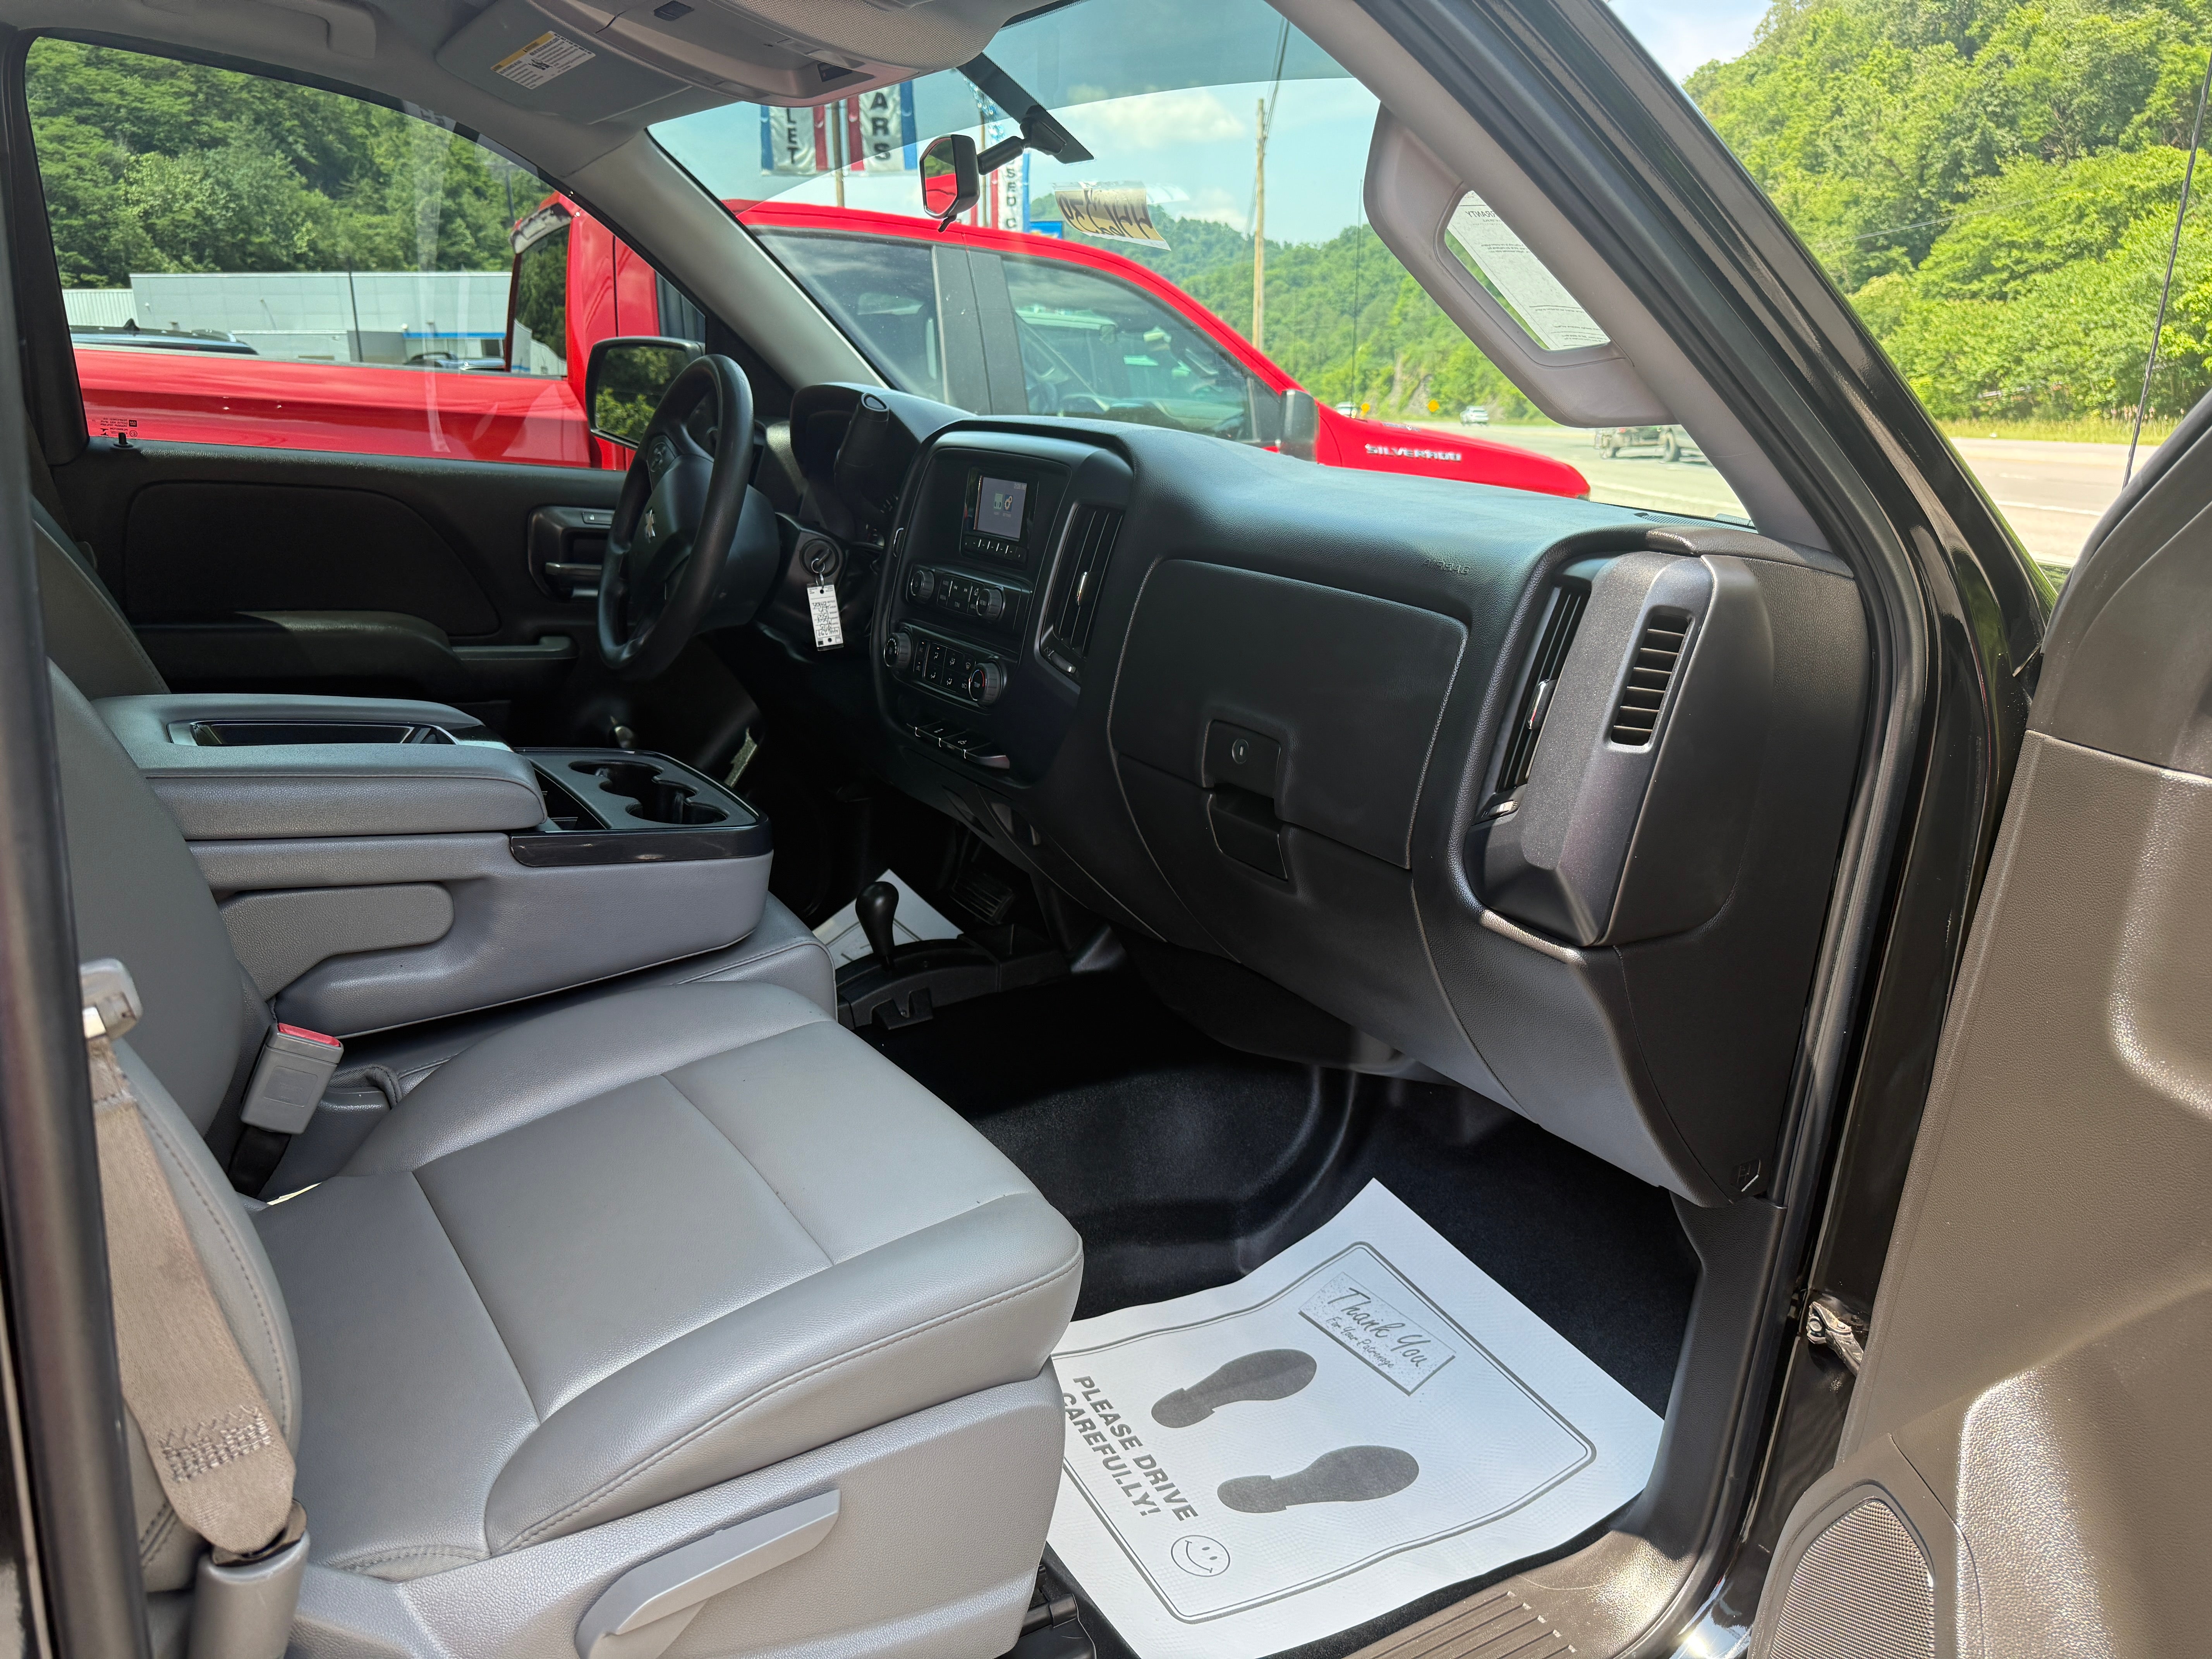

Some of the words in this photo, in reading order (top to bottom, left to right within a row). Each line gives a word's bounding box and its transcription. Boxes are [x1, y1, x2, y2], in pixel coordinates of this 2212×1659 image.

[871, 92, 890, 161] ARS
[1365, 444, 1462, 462] SILVERADO
[1420, 558, 1471, 574] AIRBAG
[1326, 1317, 1342, 1328] For
[1340, 1326, 1358, 1341] Your
[1357, 1338, 1394, 1368] Patronage
[1328, 1287, 1406, 1338] Thank
[1390, 1334, 1431, 1367] You
[1063, 1392, 1161, 1516] CAREFULLY!
[1073, 1376, 1144, 1451] PLEASE
[1132, 1454, 1199, 1522] DRIVE
